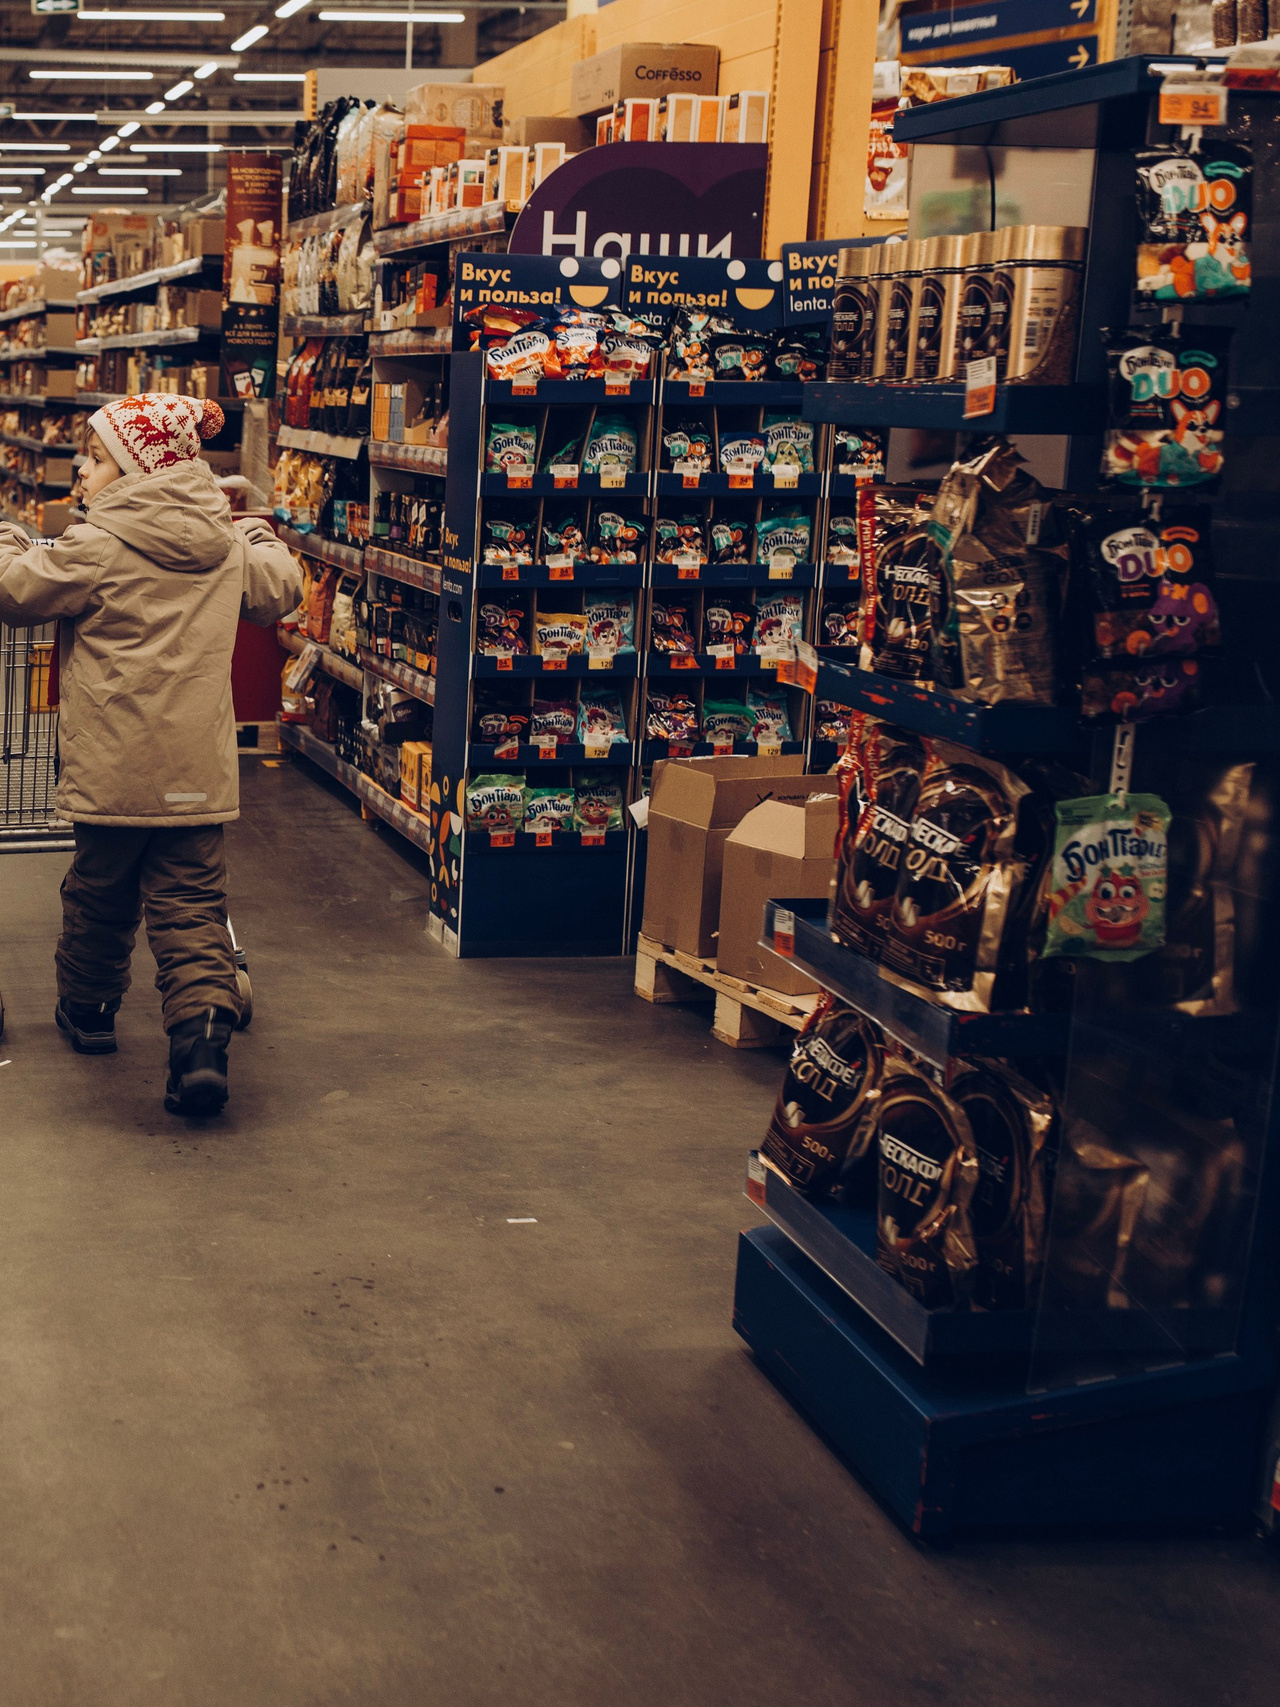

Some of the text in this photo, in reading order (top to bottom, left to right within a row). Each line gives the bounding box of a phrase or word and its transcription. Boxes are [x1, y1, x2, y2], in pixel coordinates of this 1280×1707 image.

[1161, 178, 1236, 214] DUO
[788, 252, 838, 271] Вкус
[462, 263, 511, 287] Вкус
[631, 264, 679, 289] Вкус
[460, 287, 561, 304] и польза!
[629, 289, 727, 307] и польза!
[1131, 367, 1211, 401] DUO
[445, 527, 458, 550] Вкус
[449, 557, 471, 574] польза!
[1117, 544, 1193, 582] DUO
[443, 574, 462, 595] lenta.com
[483, 722, 522, 735] DUO
[863, 832, 901, 871] ОЛД
